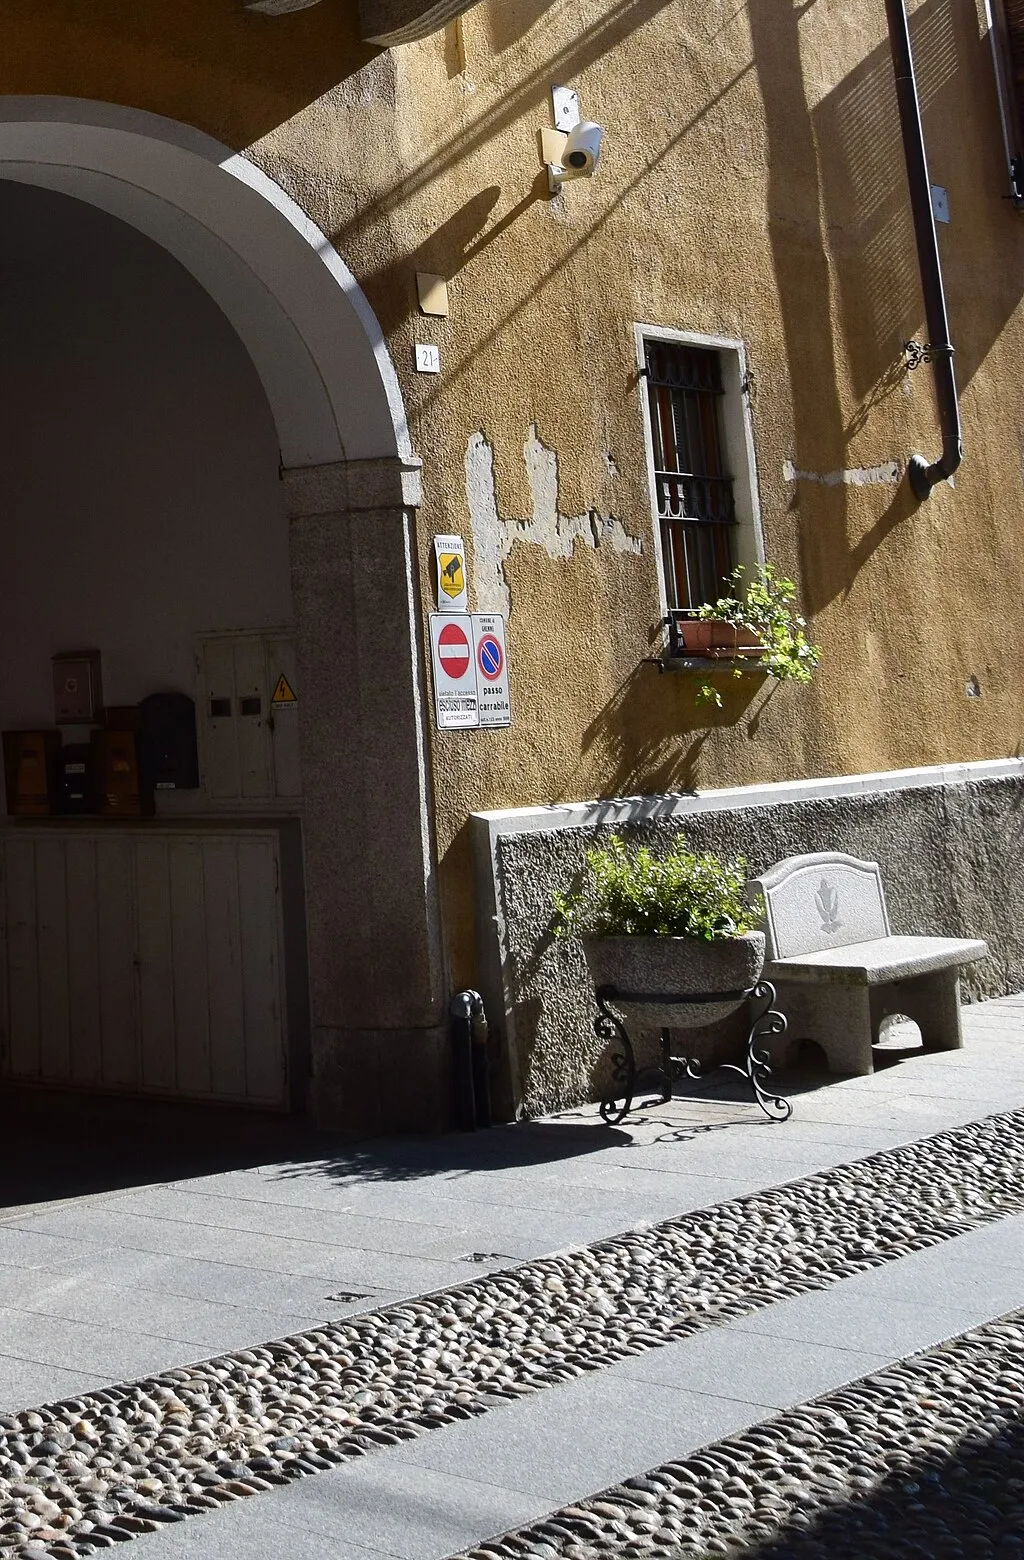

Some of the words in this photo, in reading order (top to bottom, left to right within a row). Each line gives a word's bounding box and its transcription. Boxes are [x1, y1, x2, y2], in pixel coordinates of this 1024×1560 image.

[422, 350, 433, 367] 21
[437, 542, 462, 550] ATTENZIONE
[483, 687, 503, 696] passo
[479, 700, 509, 711] carrabile
